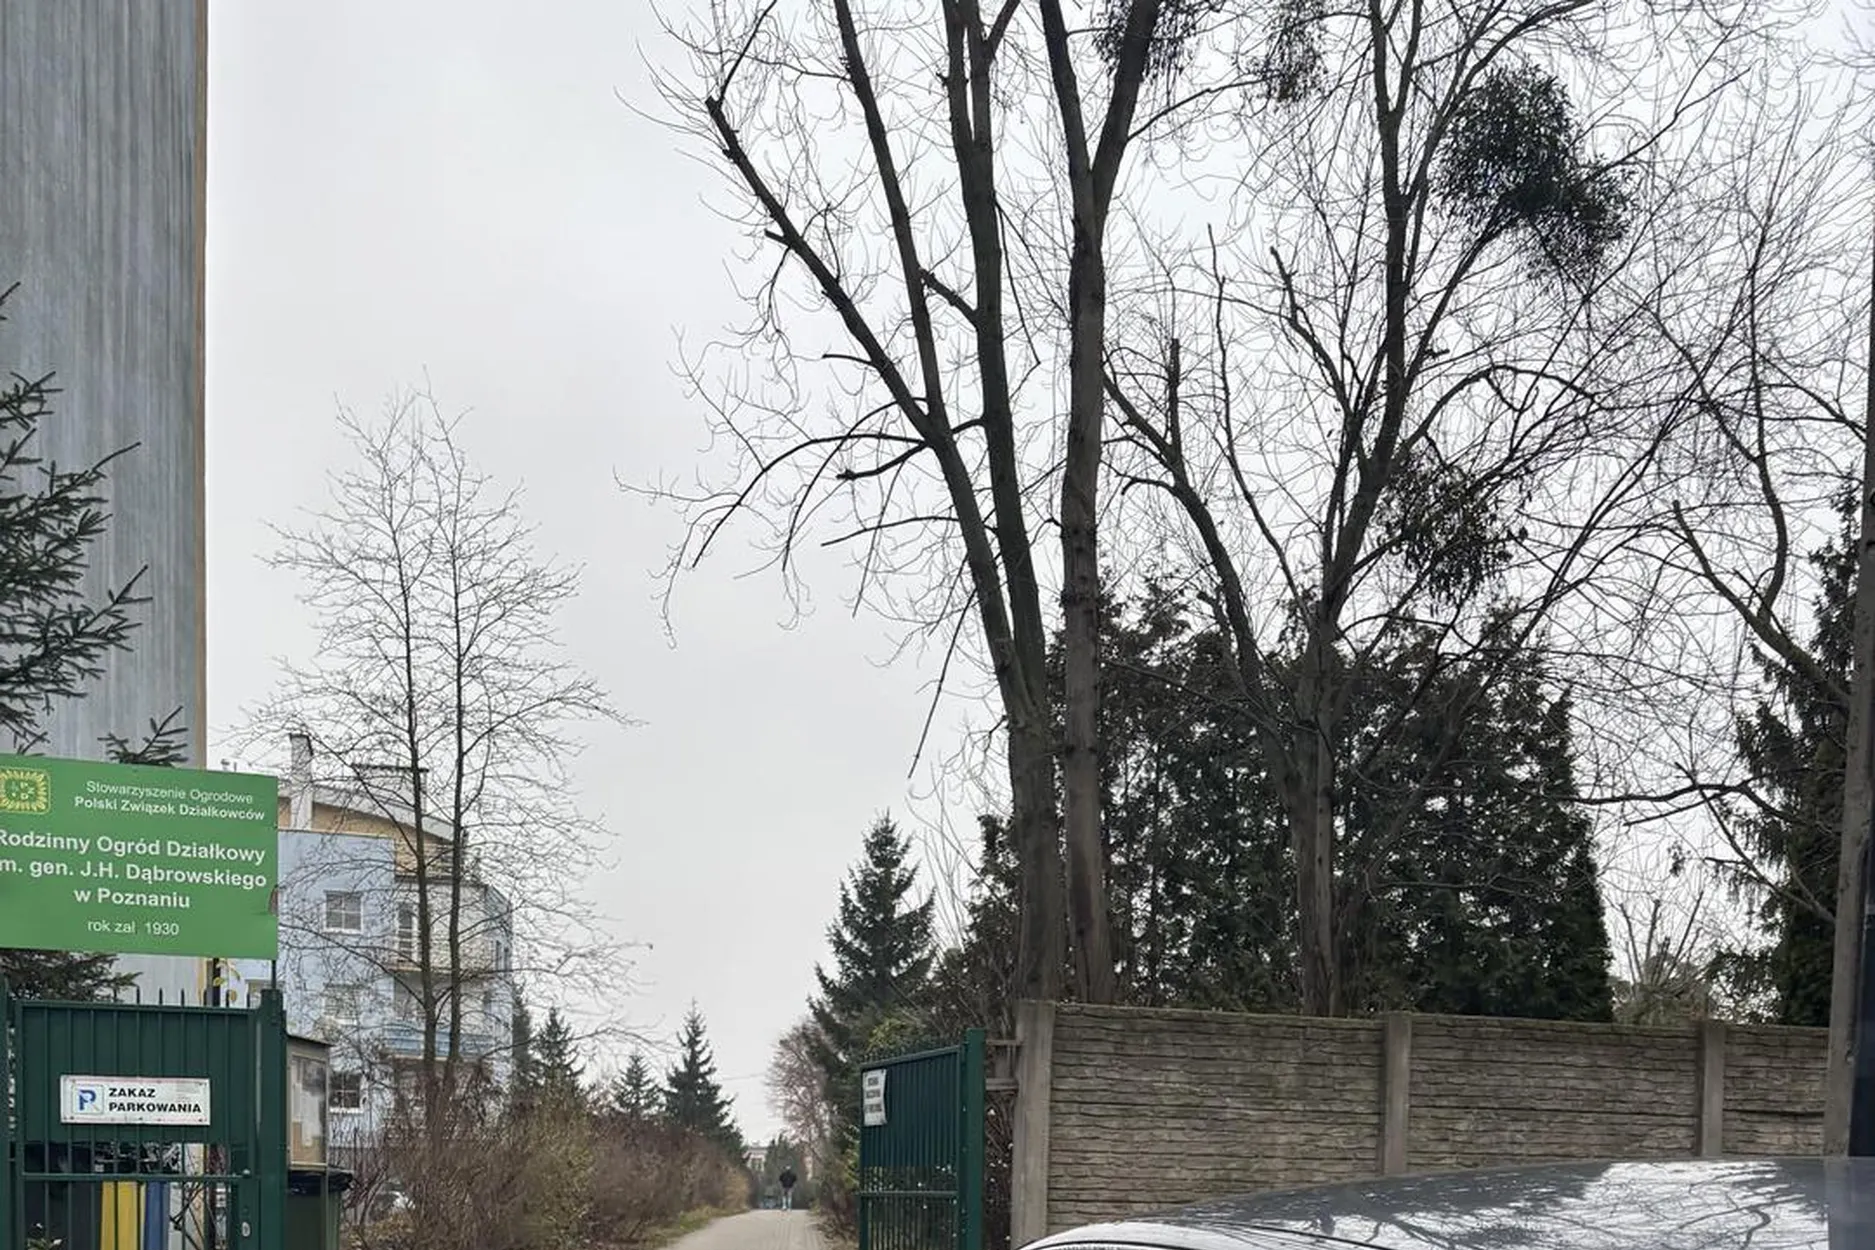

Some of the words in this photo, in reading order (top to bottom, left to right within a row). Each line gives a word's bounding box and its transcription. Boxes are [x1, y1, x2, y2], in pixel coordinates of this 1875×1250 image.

[74, 796, 117, 810] Polski
[0, 829, 90, 855] Rodzinny
[97, 836, 160, 857] Ogród
[167, 840, 265, 866] Działkowy
[29, 860, 74, 878] gen.
[80, 860, 119, 878] J.H.
[126, 863, 267, 890] Dąbrowskiego
[74, 889, 91, 903] w
[97, 887, 190, 908] Poznaniu
[87, 920, 110, 932] rok
[145, 921, 180, 935] 1930
[108, 1087, 156, 1098] ZAKAZ
[108, 1101, 202, 1113] PARKOWANIA
